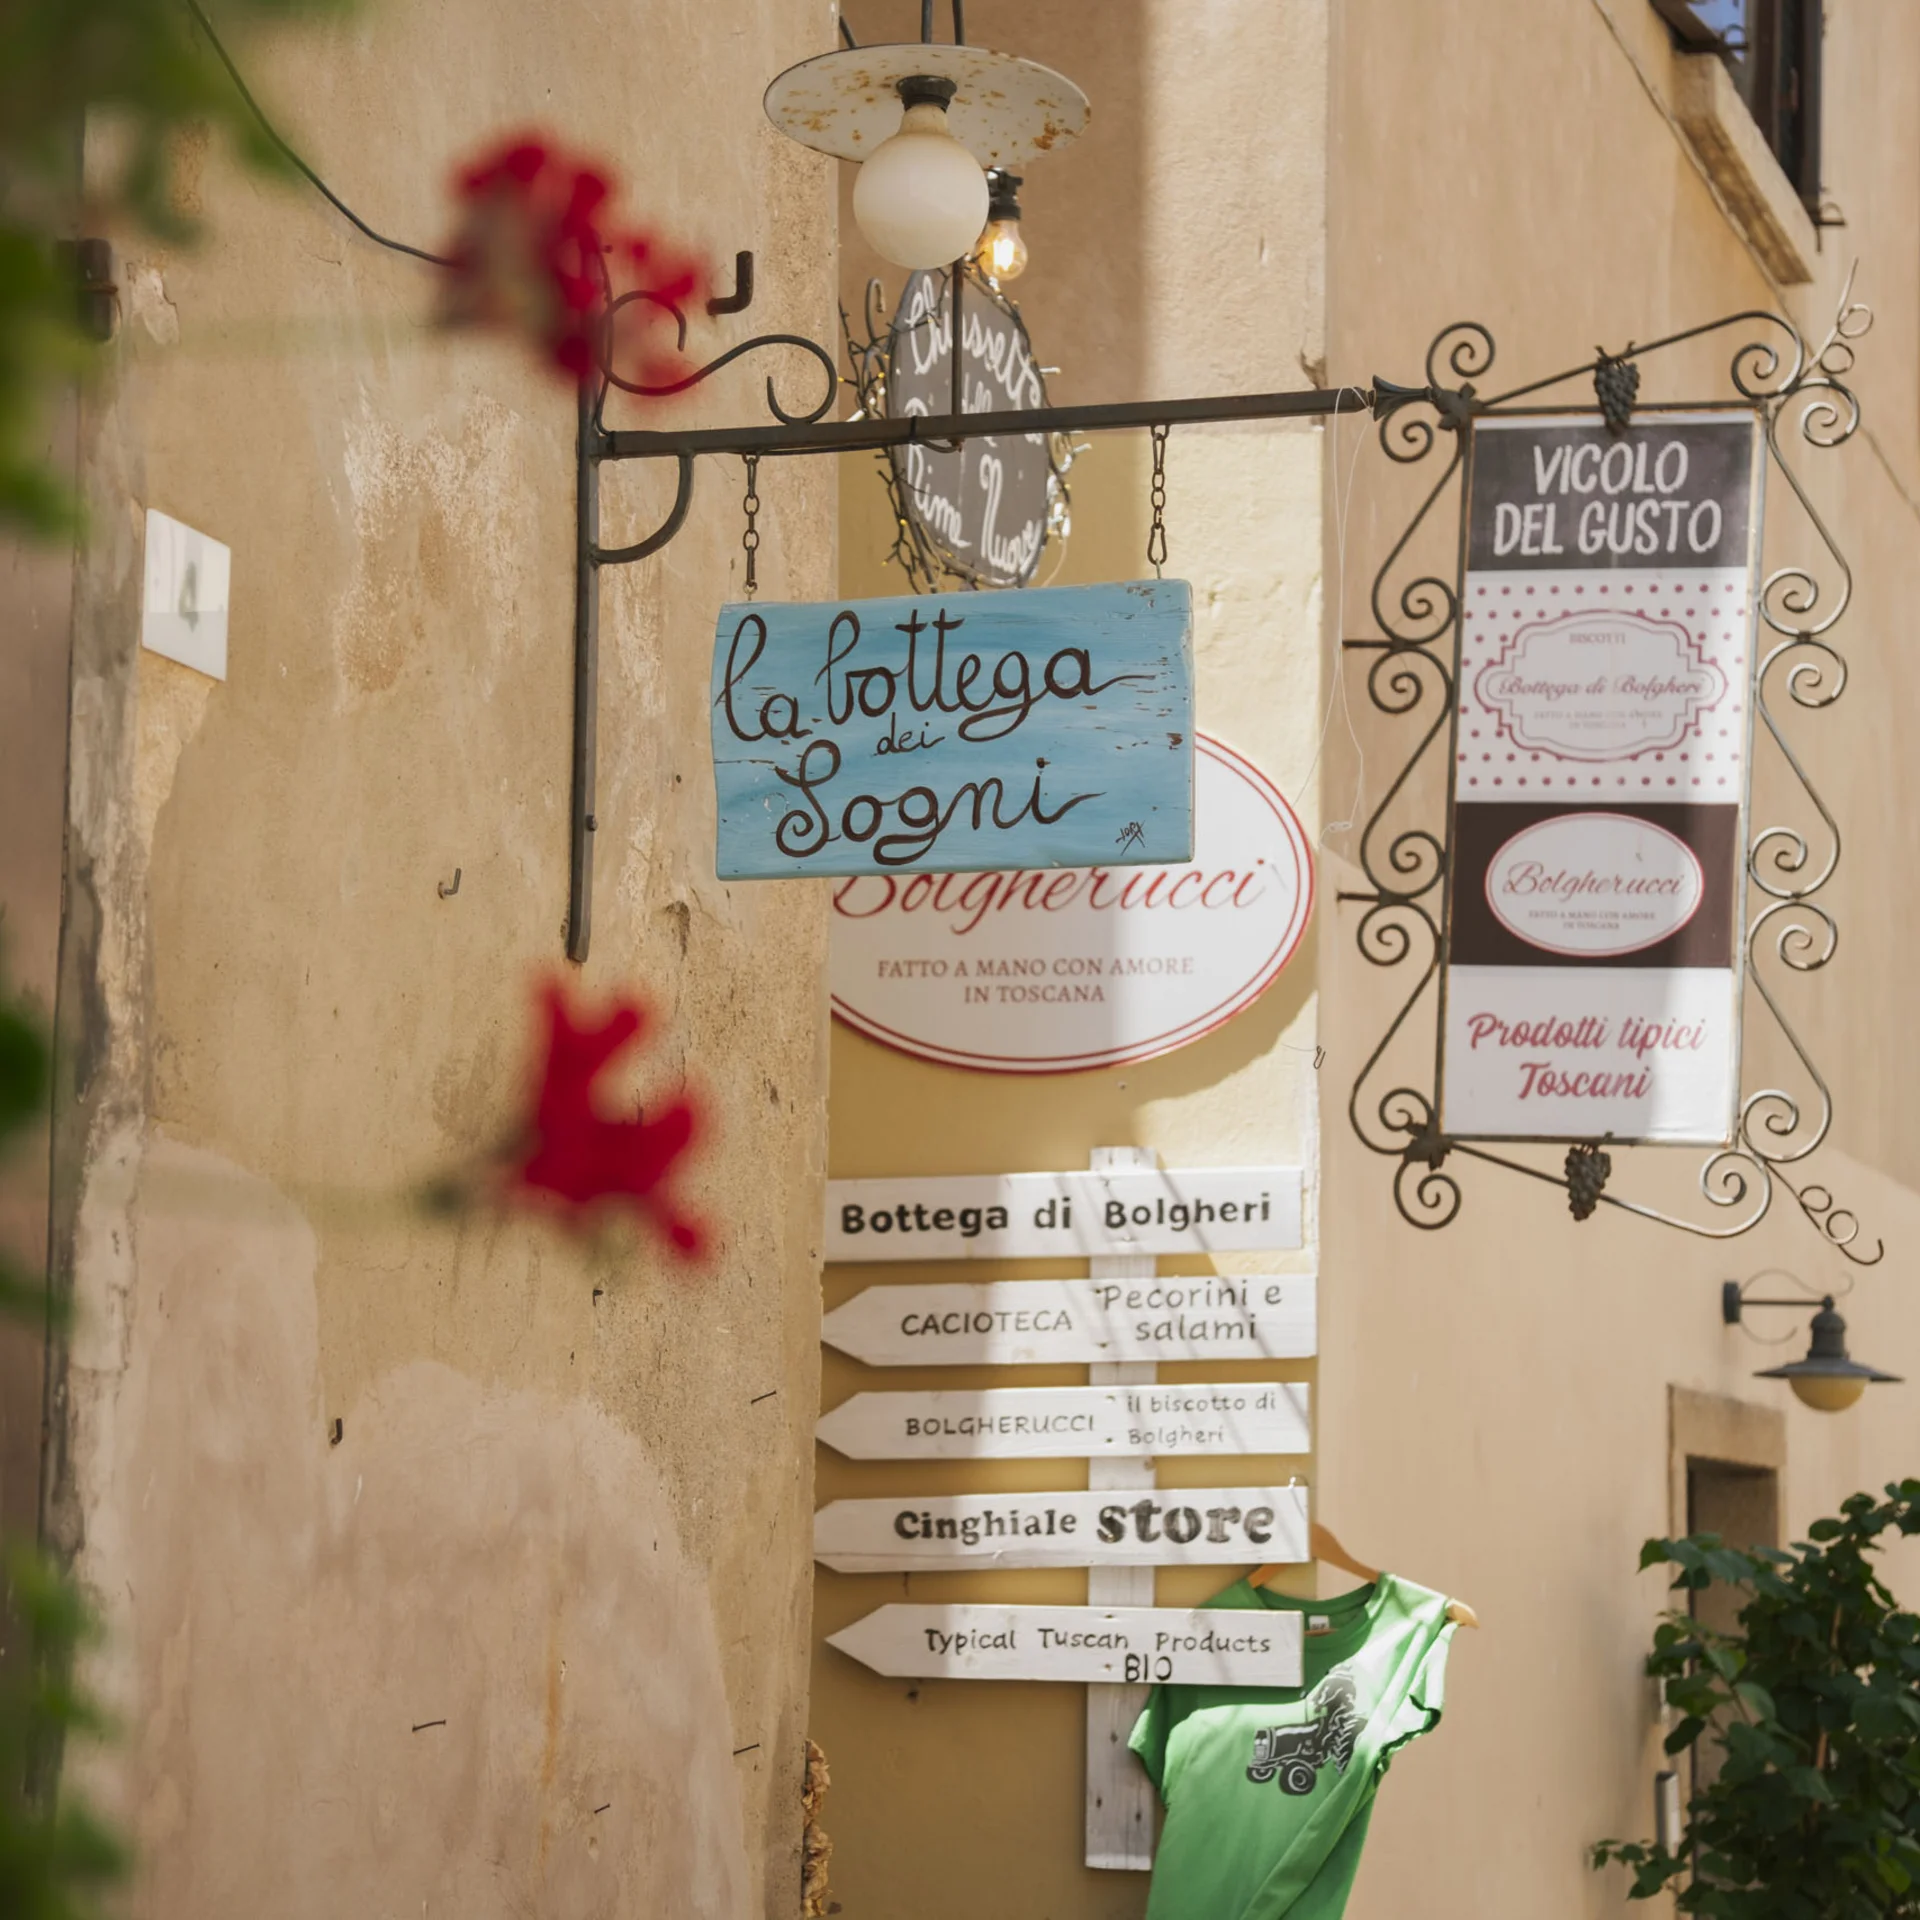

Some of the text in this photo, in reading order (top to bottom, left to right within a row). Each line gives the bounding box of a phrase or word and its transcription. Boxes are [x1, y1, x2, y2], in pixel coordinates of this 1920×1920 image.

[1534, 441, 1689, 495] VICOLO
[1493, 498, 1722, 555] DEL GUSTO
[814, 607, 1157, 743] bottega
[1499, 675, 1580, 701] Bottega
[1585, 675, 1606, 695] di
[874, 711, 945, 755] dei
[774, 739, 1107, 866] Sogni
[1502, 860, 1686, 902] Bolgherucci
[877, 956, 1196, 979] FATTO A MANO CON AMORE
[964, 983, 1106, 1004] IN TOSCANA
[1467, 1012, 1708, 1060] Prodotti tipici
[1518, 1062, 1652, 1101] Toscani
[841, 1192, 1271, 1238] Bottega di Bolgheri
[1102, 1279, 1283, 1311] Pecorini e
[901, 1309, 1074, 1337] CACIOTECA
[1135, 1313, 1258, 1342] salami
[1150, 1395, 1247, 1412] biscotto
[1255, 1392, 1276, 1411] di
[905, 1414, 1094, 1437] BOLGHERUCCI
[1127, 1425, 1225, 1448] Bolgheri
[894, 1499, 1275, 1546] Cinghiale store
[924, 1627, 1272, 1656] Typical Tuscan Products
[1124, 1652, 1173, 1684] BIO
